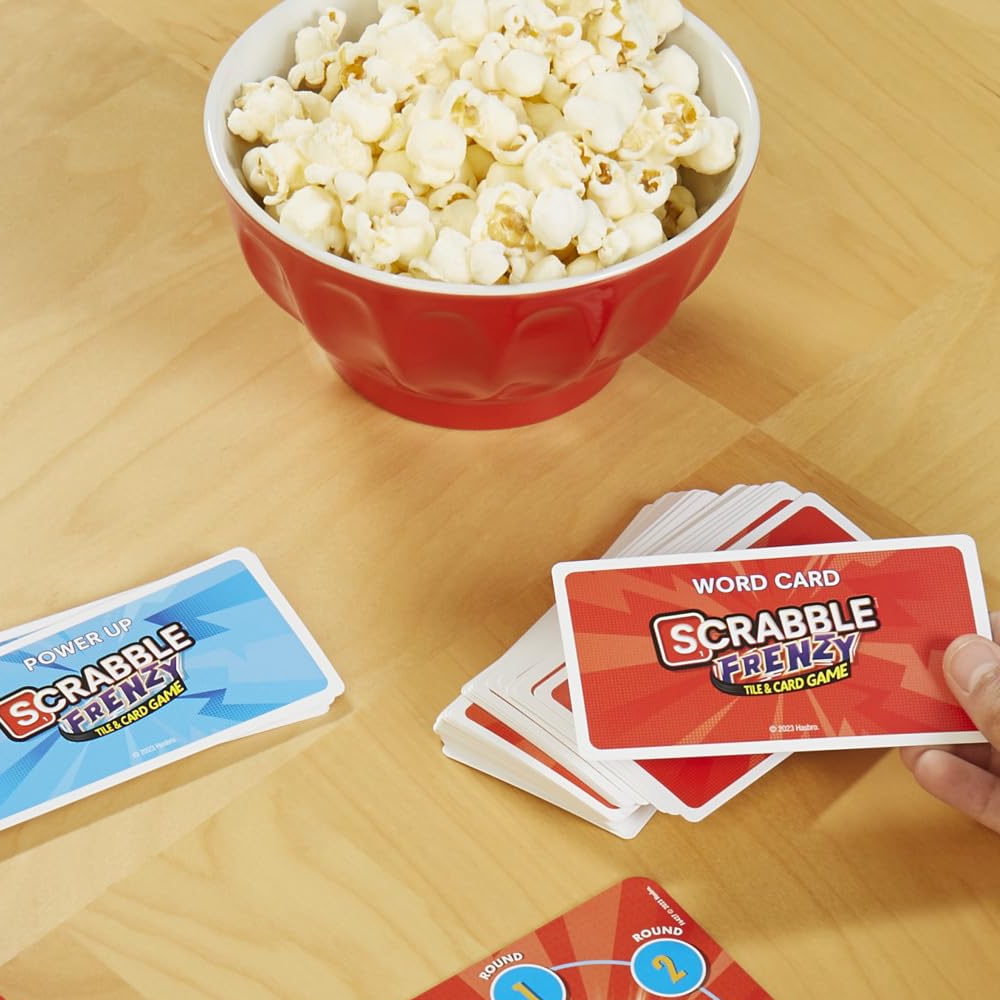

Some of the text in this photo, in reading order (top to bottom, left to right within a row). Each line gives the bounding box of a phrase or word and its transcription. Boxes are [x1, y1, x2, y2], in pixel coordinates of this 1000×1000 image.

[692, 570, 840, 594] WORD CARD
[23, 618, 133, 672] POWER UP
[670, 597, 877, 655] SCRABBLE
[9, 624, 193, 726] SCRABBLE
[716, 632, 859, 683] FRENZY
[744, 663, 849, 696] TILE & CARD GAME
[63, 656, 179, 734] FRENZY
[96, 680, 184, 737] TILE & CARD GAME
[632, 926, 684, 942] ROUND
[479, 952, 524, 981] ROUND
[651, 955, 687, 984] 2
